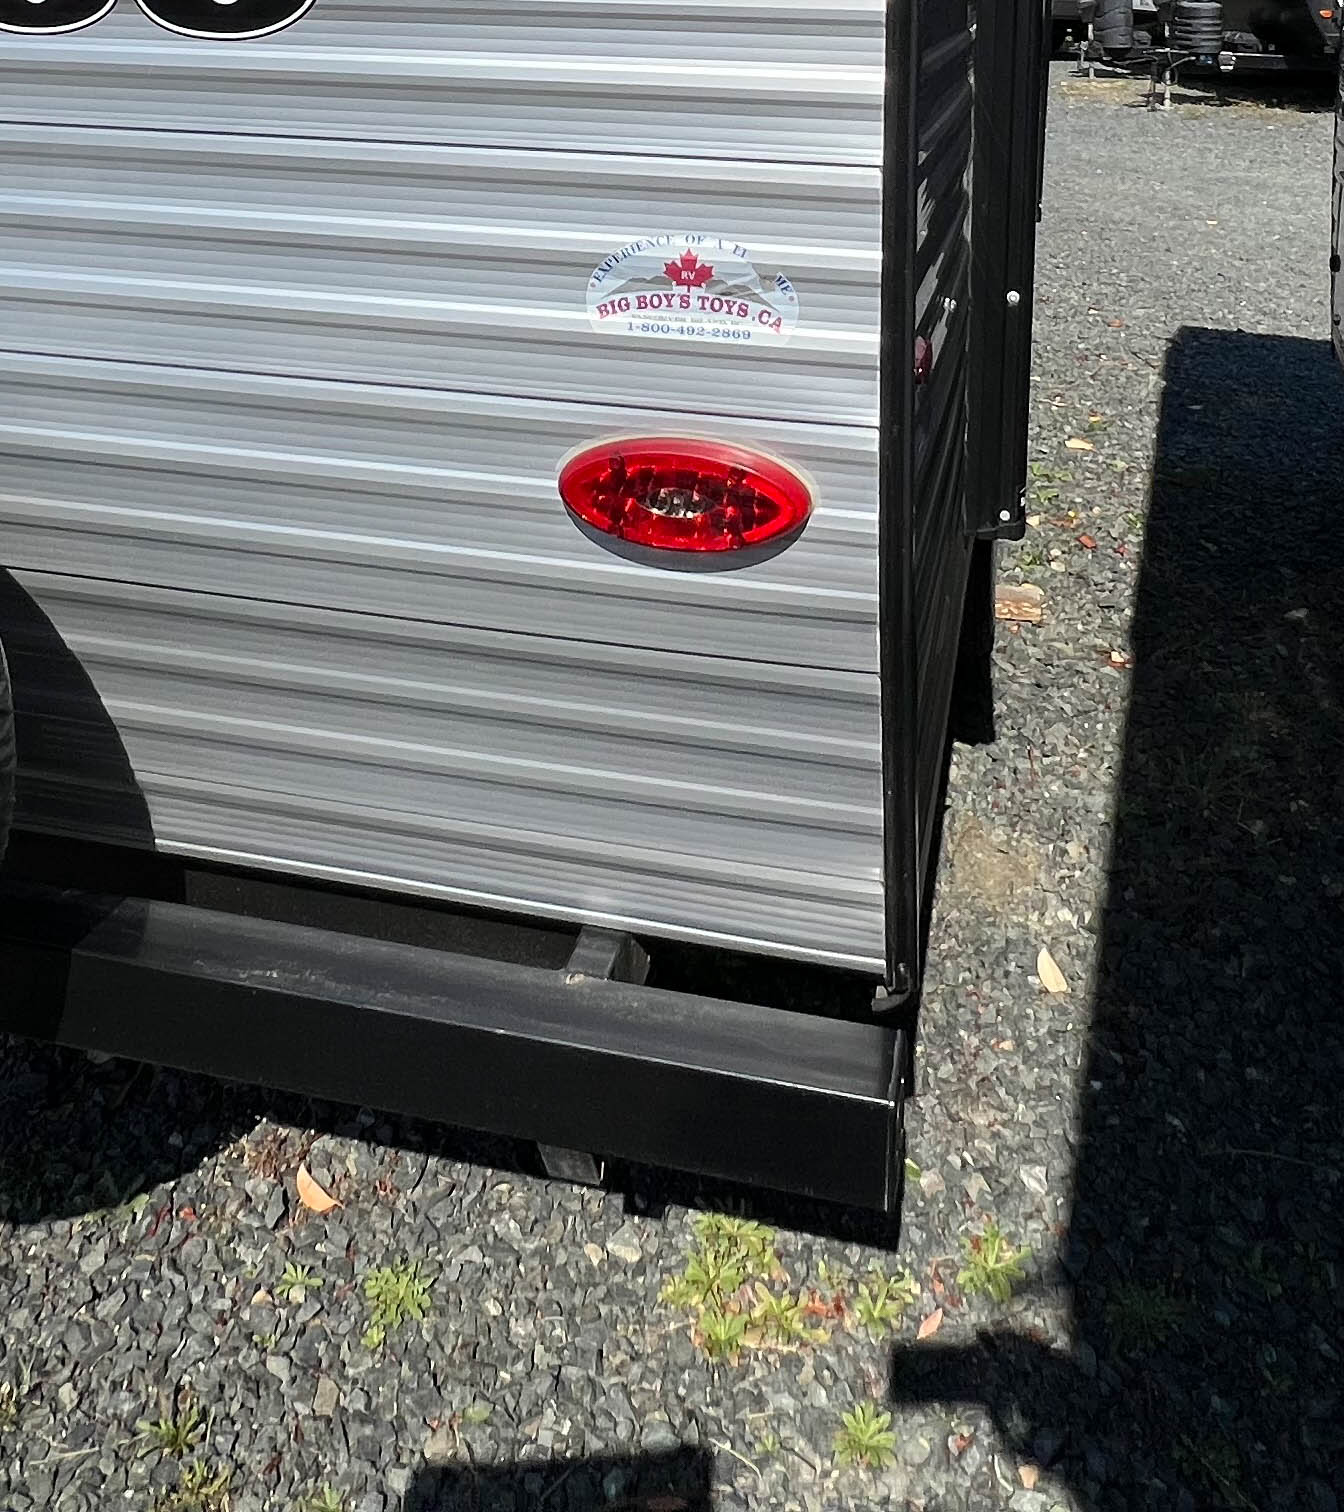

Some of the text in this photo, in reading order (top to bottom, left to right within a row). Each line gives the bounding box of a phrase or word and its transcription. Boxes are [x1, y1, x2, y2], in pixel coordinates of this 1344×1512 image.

[680, 270, 696, 281] RV
[596, 297, 631, 319] BIG
[636, 292, 691, 311] BOY'S
